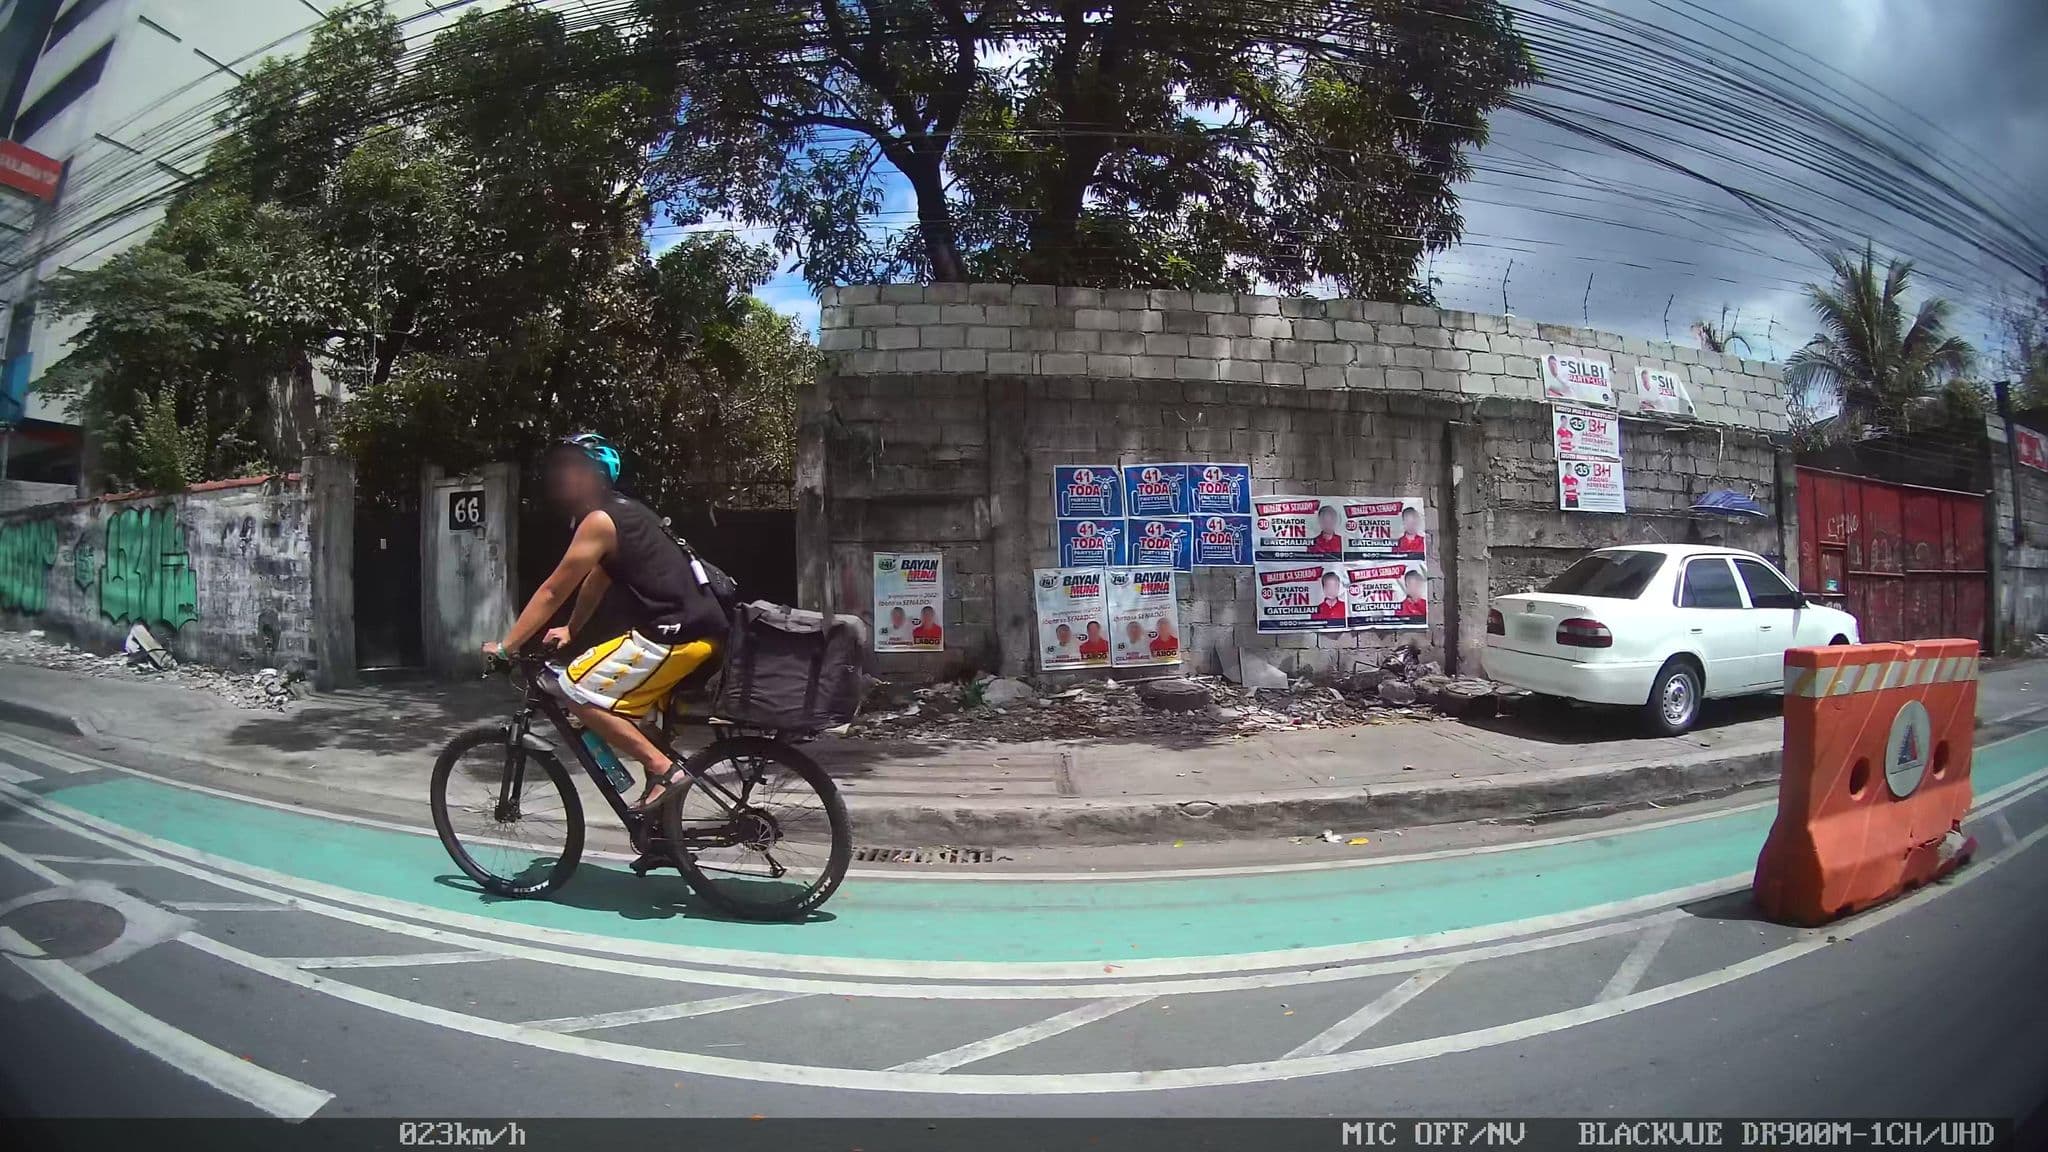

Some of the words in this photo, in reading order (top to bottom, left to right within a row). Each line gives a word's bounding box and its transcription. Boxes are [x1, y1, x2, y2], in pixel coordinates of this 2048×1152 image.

[1568, 360, 1605, 379] SILBI
[1568, 374, 1608, 387] PARTY-LIST
[1589, 419, 1606, 434] BH
[1144, 470, 1158, 481] 41
[1206, 469, 1220, 480] 41
[1594, 463, 1611, 477] BH
[1076, 470, 1090, 483] 41
[1068, 485, 1100, 496] TODA
[1138, 484, 1169, 495] TODA
[1200, 483, 1229, 493] TODA
[455, 497, 479, 522] 66
[1080, 524, 1093, 535] 41
[1148, 524, 1162, 535] 41
[1209, 519, 1223, 530] 41
[1271, 525, 1306, 538] WIN
[1359, 526, 1391, 538] WIN
[1072, 538, 1105, 548] TODA
[1140, 538, 1170, 549] TODA
[1203, 533, 1232, 543] TODA
[901, 560, 939, 570] BAYAN
[908, 570, 937, 579] MUNA
[1134, 572, 1170, 583] BAYAN
[1063, 575, 1100, 586] BAYAN
[1071, 585, 1099, 595] MUNA
[1141, 583, 1169, 592] MUNA
[1275, 592, 1310, 606] WIN
[1363, 590, 1394, 602] WIN
[657, 623, 682, 635] 77
